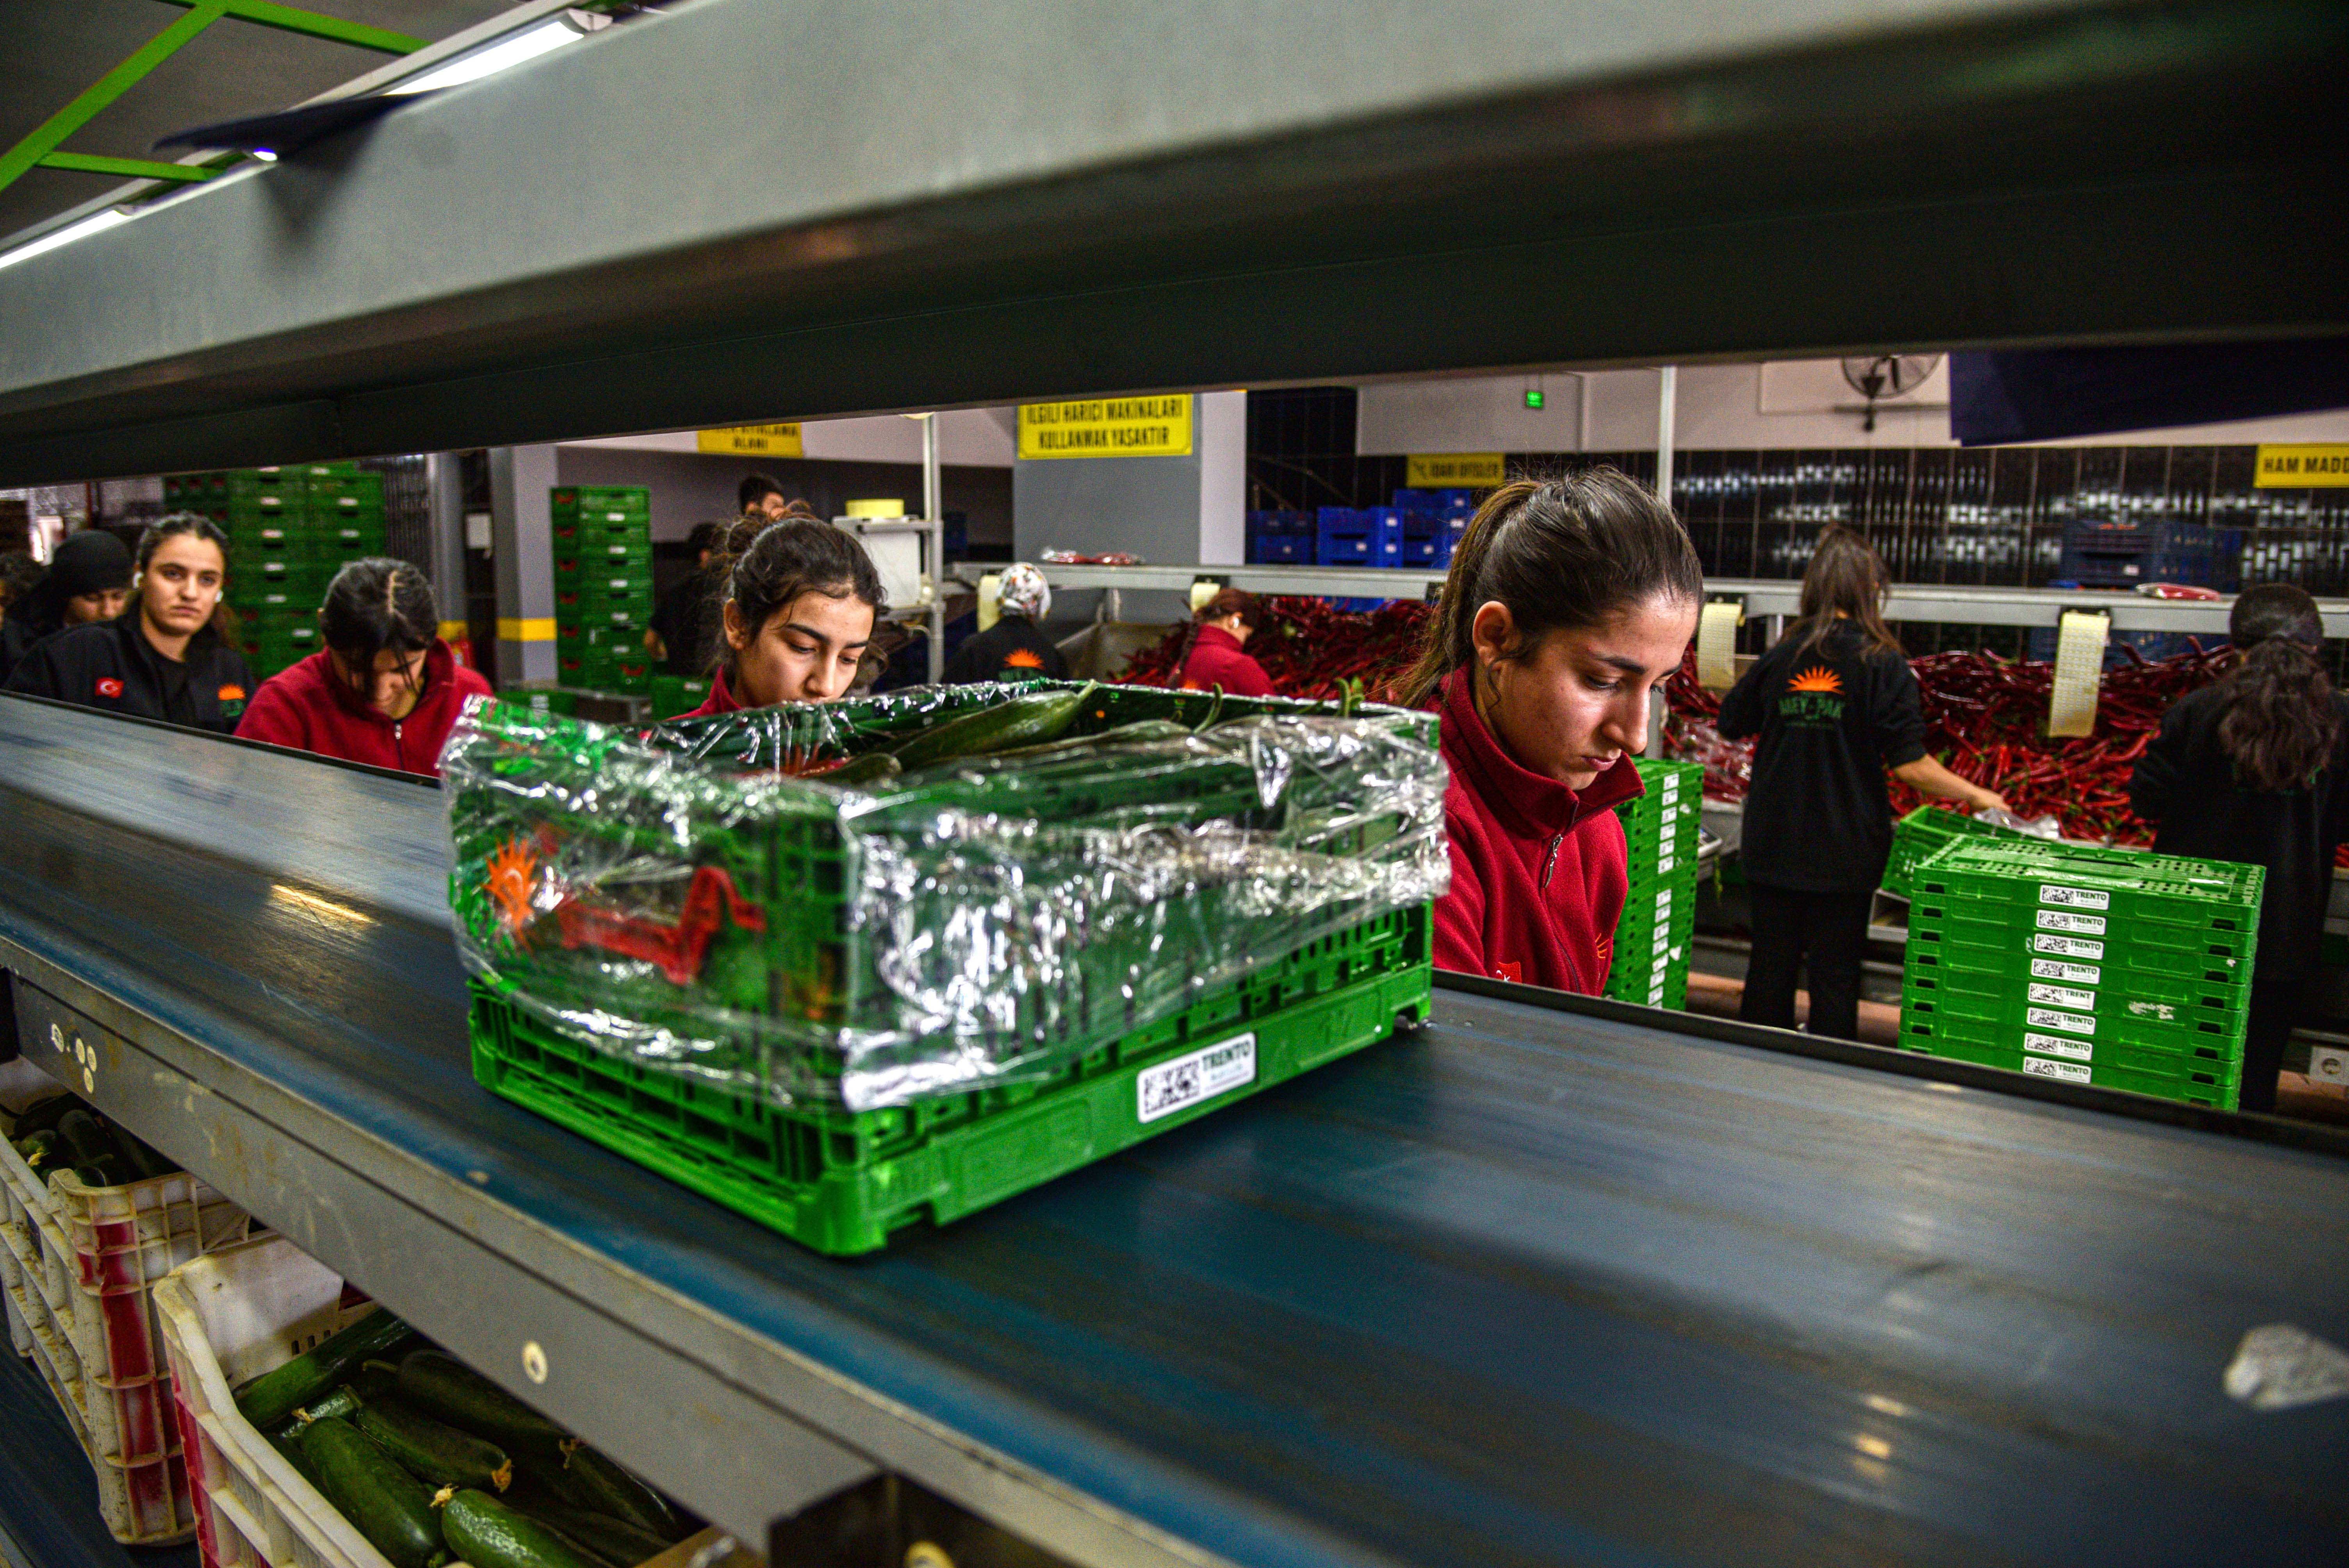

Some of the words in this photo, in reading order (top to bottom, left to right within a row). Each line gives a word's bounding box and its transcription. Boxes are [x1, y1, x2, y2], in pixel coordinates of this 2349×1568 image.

[1039, 428, 1109, 449] KULLANMAK
[1112, 426, 1169, 447] YASAKTIR
[2263, 456, 2299, 473] HAM
[2075, 891, 2107, 900] TRENTO
[2072, 916, 2103, 926] TRENTO
[2070, 940, 2101, 950] TRENTO
[2067, 964, 2097, 975] TRENTO
[2065, 990, 2091, 998] TRENT
[2063, 1014, 2094, 1025] TRENTO
[2060, 1041, 2090, 1051] TRENTO
[1202, 1041, 1250, 1071] TRENTO
[2058, 1064, 2089, 1074] TRENTO
